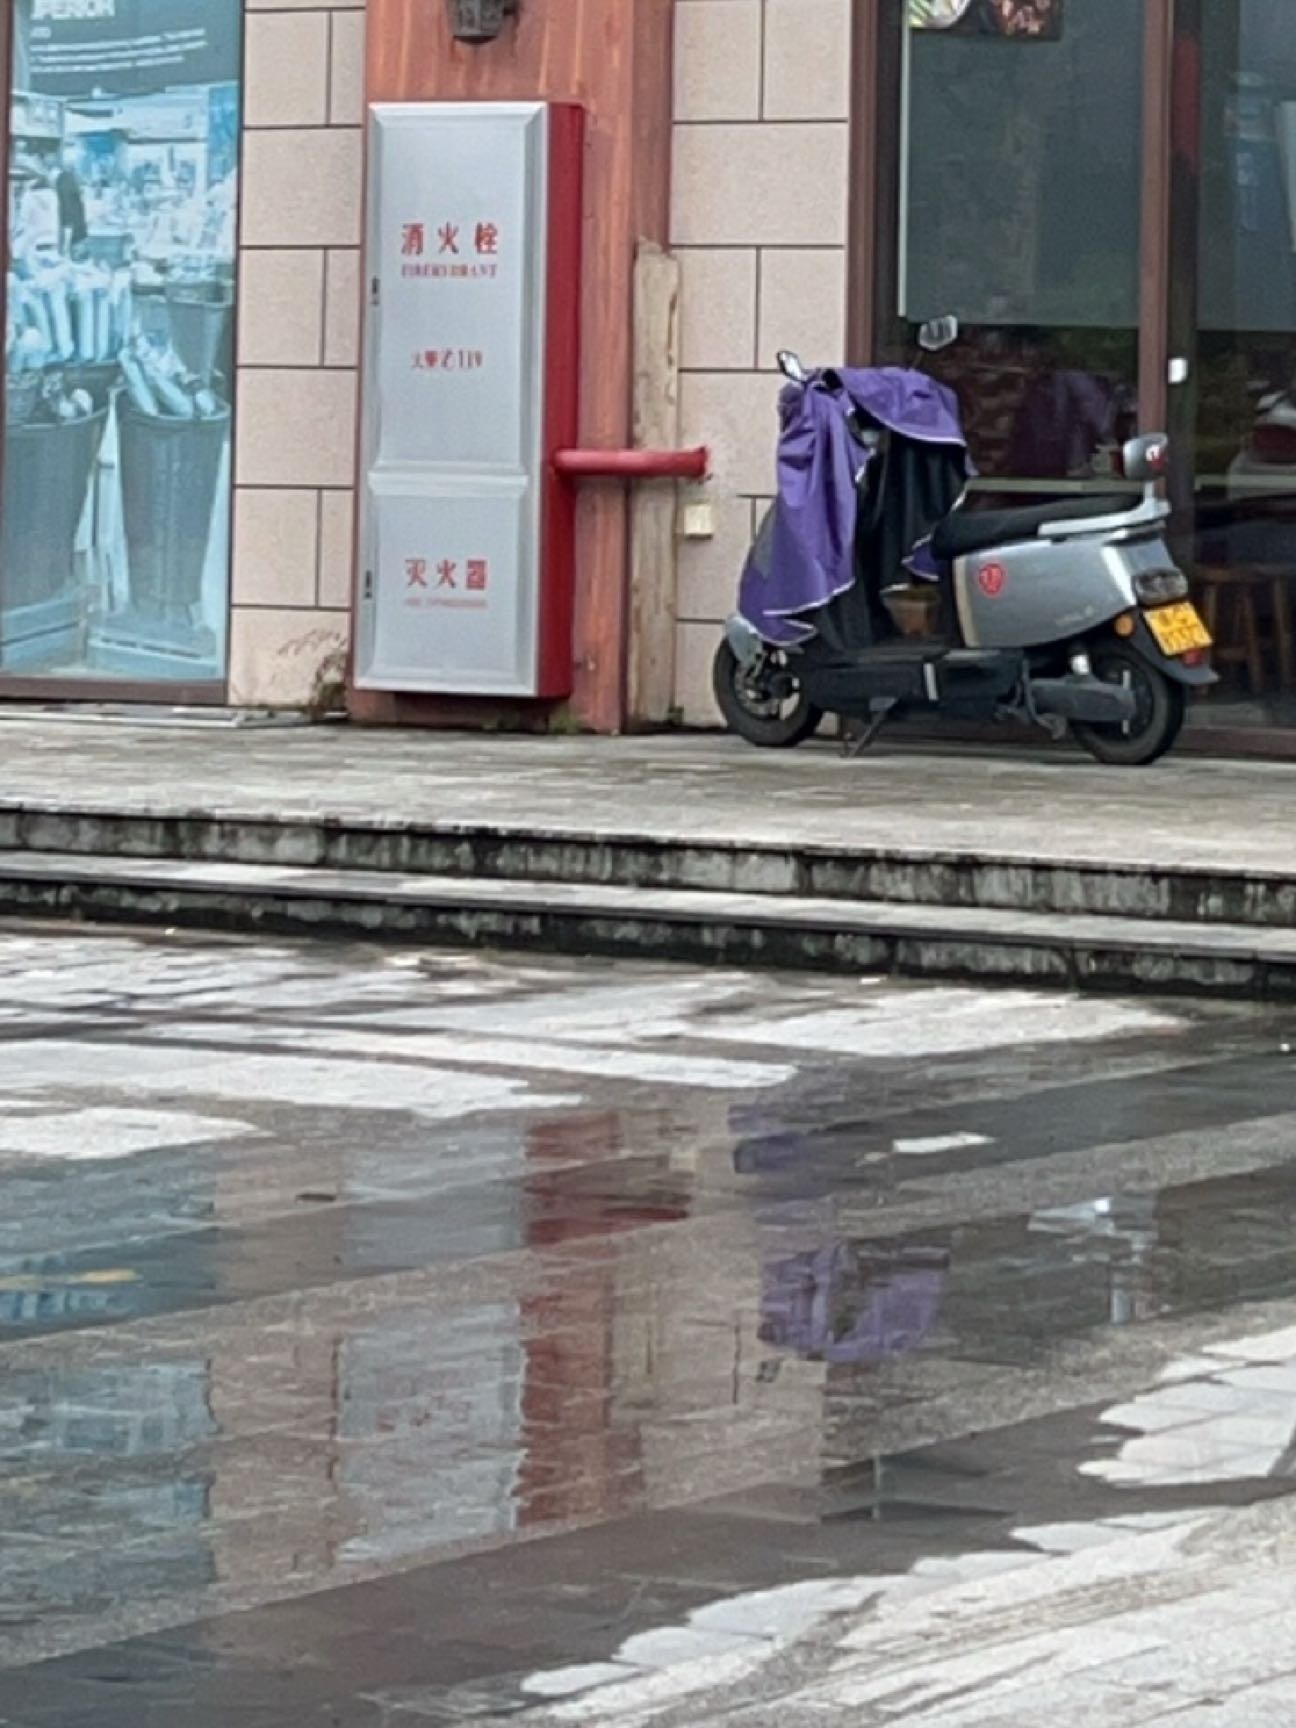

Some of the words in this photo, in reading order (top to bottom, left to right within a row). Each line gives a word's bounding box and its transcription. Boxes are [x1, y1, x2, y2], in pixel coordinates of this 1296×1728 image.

[401, 222, 498, 255] 消火栓
[404, 558, 487, 591] 灭火器
